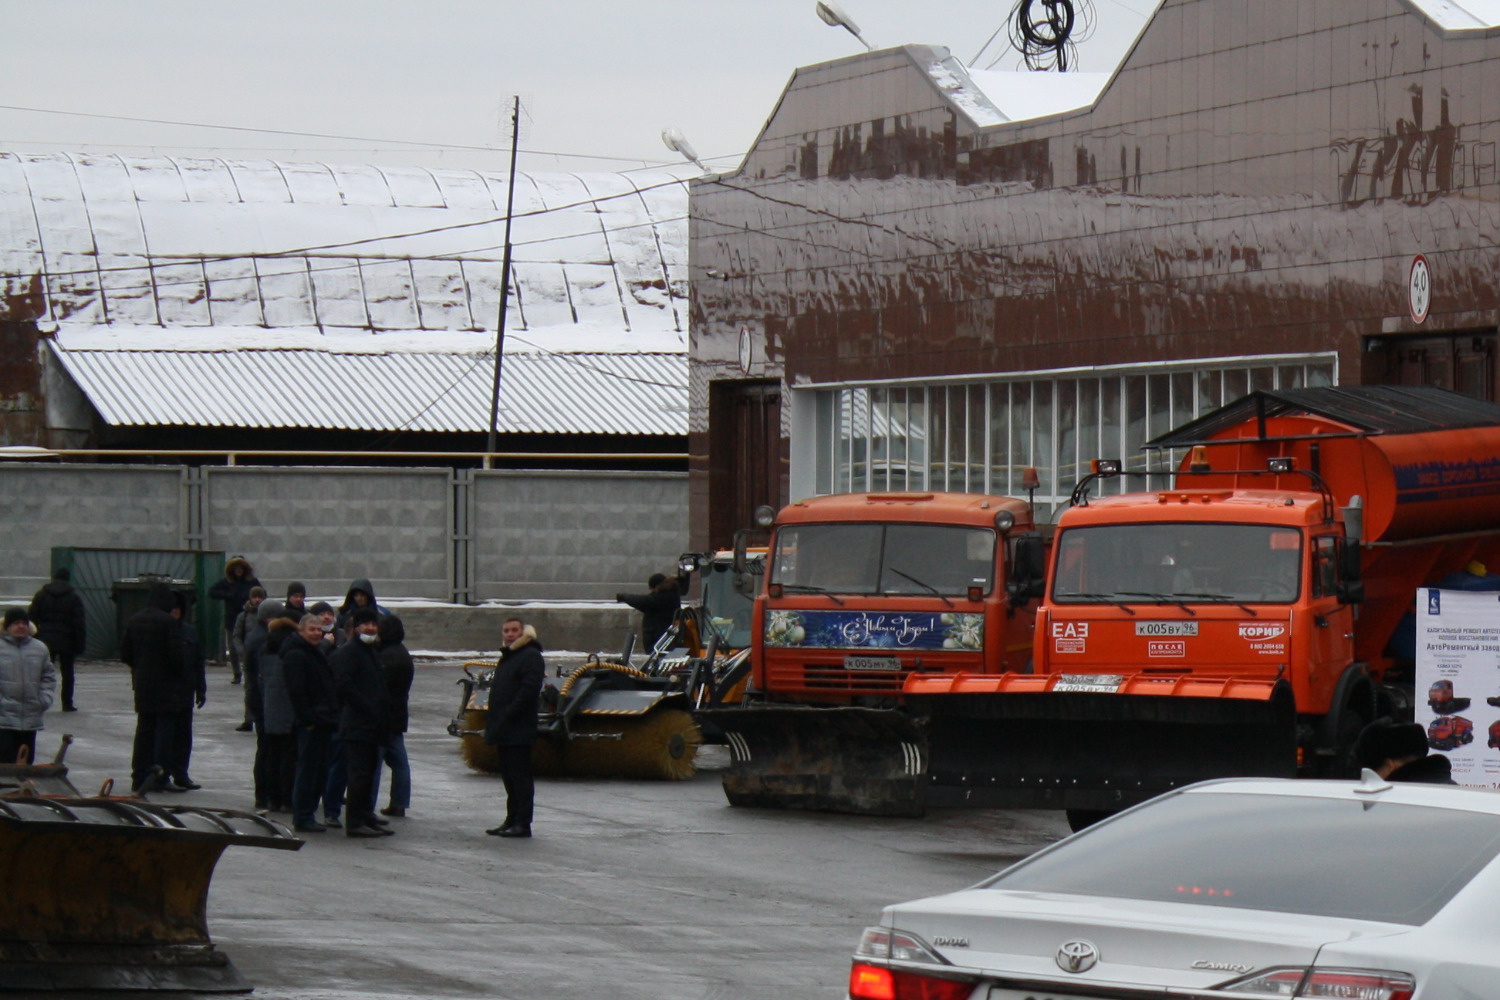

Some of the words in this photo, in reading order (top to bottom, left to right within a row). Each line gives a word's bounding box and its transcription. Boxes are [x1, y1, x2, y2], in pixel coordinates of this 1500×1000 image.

[1183, 623, 1195, 632] 96
[1238, 627, 1284, 638] КОРИБ
[933, 935, 970, 948] TOYOTA
